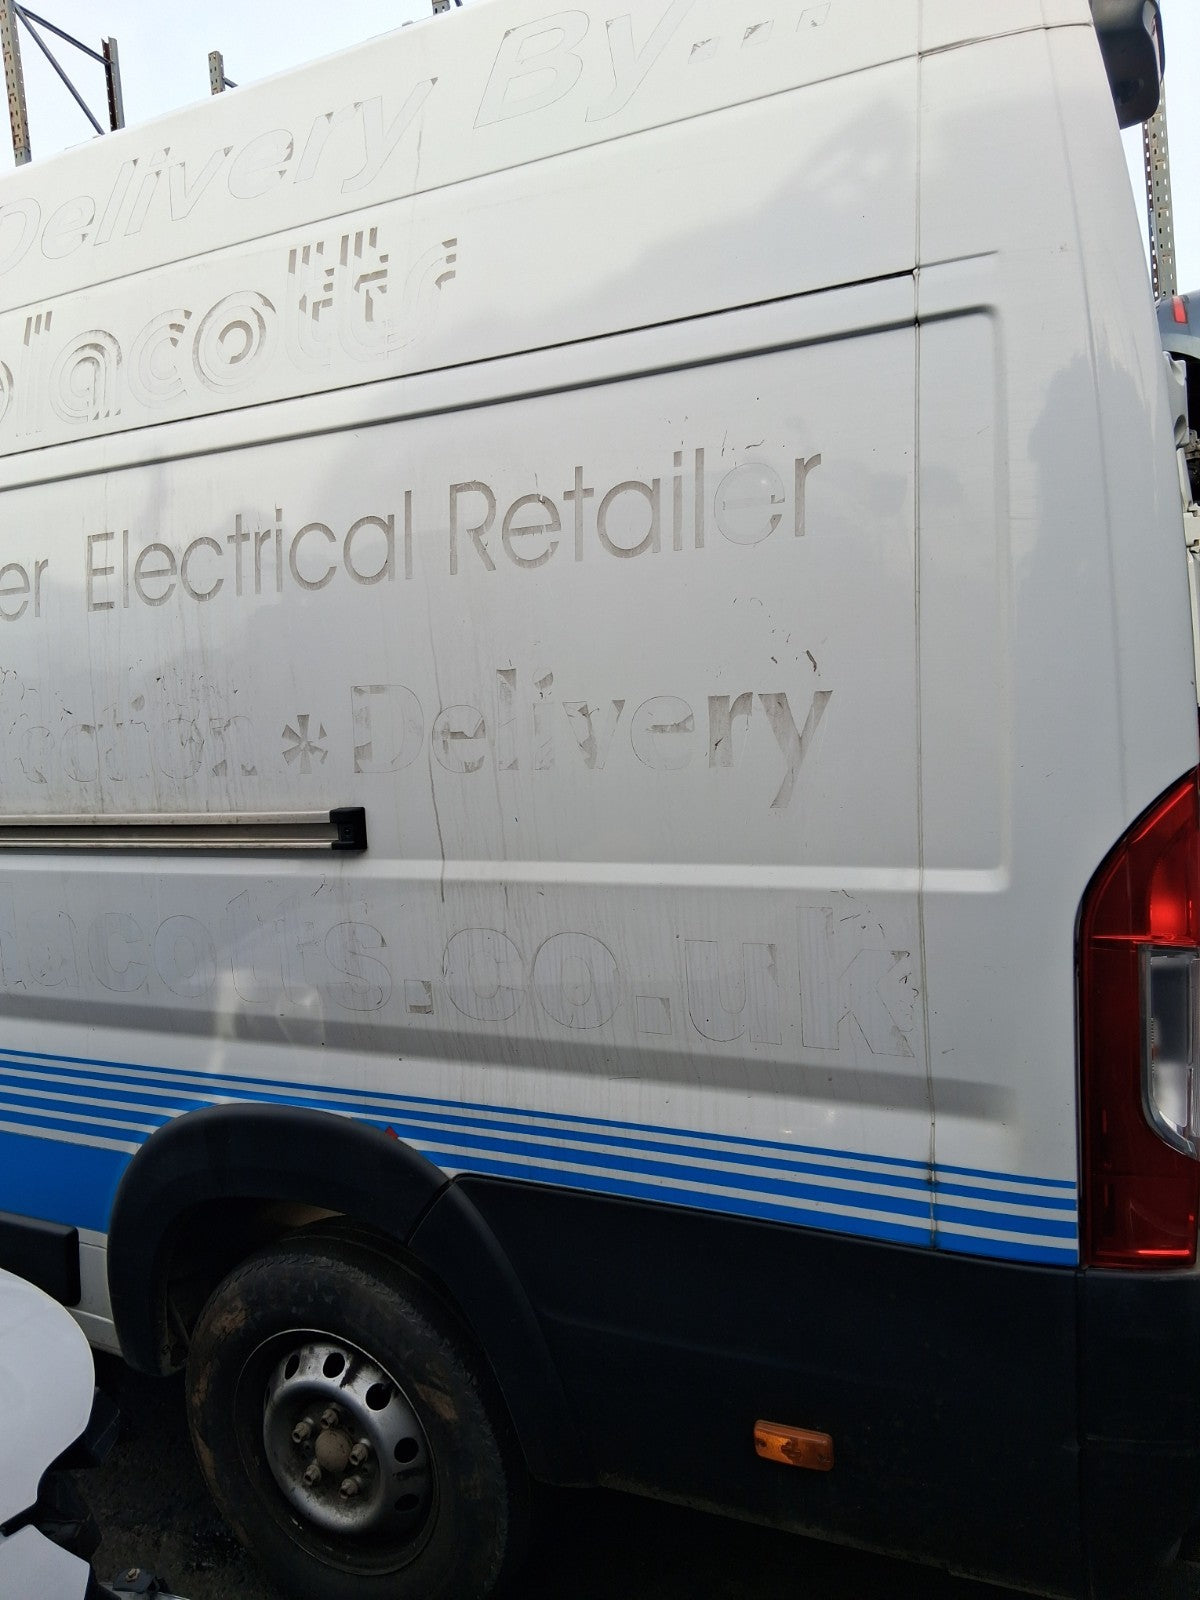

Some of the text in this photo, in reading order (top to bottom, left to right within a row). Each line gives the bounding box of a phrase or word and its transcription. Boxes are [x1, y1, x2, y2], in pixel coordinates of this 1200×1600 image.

[0, 227, 458, 437] lacotts
[87, 490, 413, 612] Electrical
[449, 447, 823, 576] Retailer
[351, 668, 832, 808] Delivery
